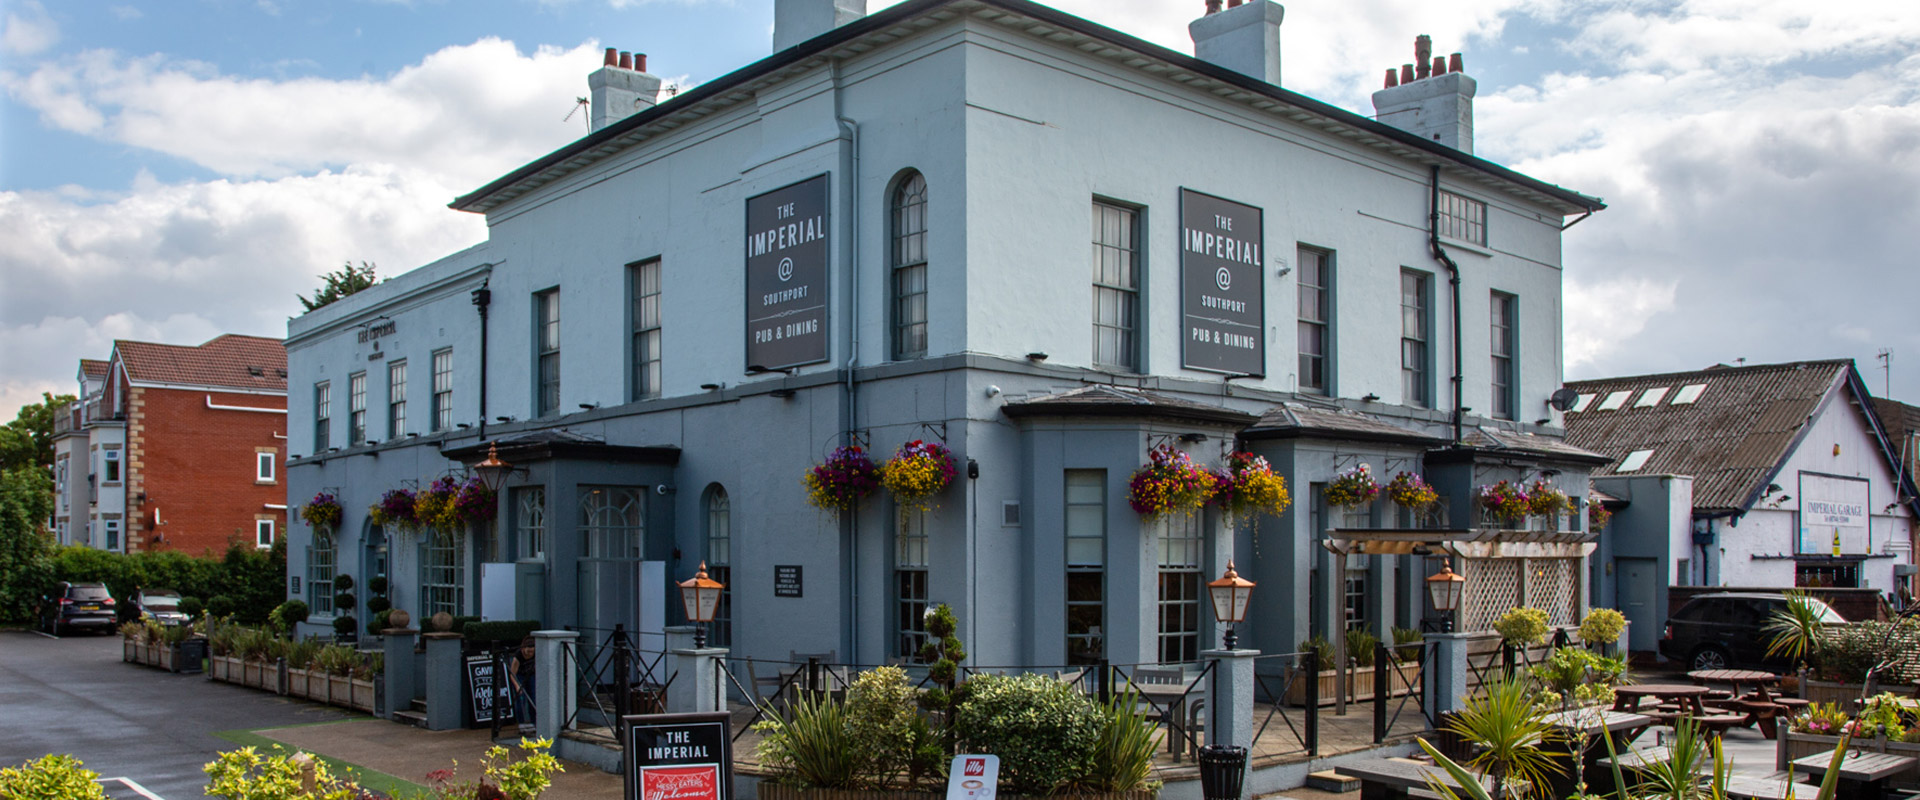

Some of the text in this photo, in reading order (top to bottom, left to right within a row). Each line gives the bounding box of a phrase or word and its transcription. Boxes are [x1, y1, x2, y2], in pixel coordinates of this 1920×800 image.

[777, 202, 795, 220] THE
[1214, 214, 1232, 231] THE
[749, 215, 825, 258] IMPERIAL
[1185, 227, 1261, 266] IMPERIAL
[778, 257, 793, 282] @
[1215, 267, 1231, 291] @
[763, 285, 808, 306] SOUTHPORT
[1201, 295, 1246, 313] SOUTHPORT
[755, 319, 818, 344] PUB & DINING
[1192, 327, 1255, 350] PUB & DINING
[1807, 501, 1863, 517] IMPERIAL GARAGE
[666, 731, 690, 744] THE
[648, 745, 709, 760] IMPERIAL
[966, 761, 984, 775] illy
[652, 787, 711, 800] Welcome
[679, 780, 703, 789] EATERS
